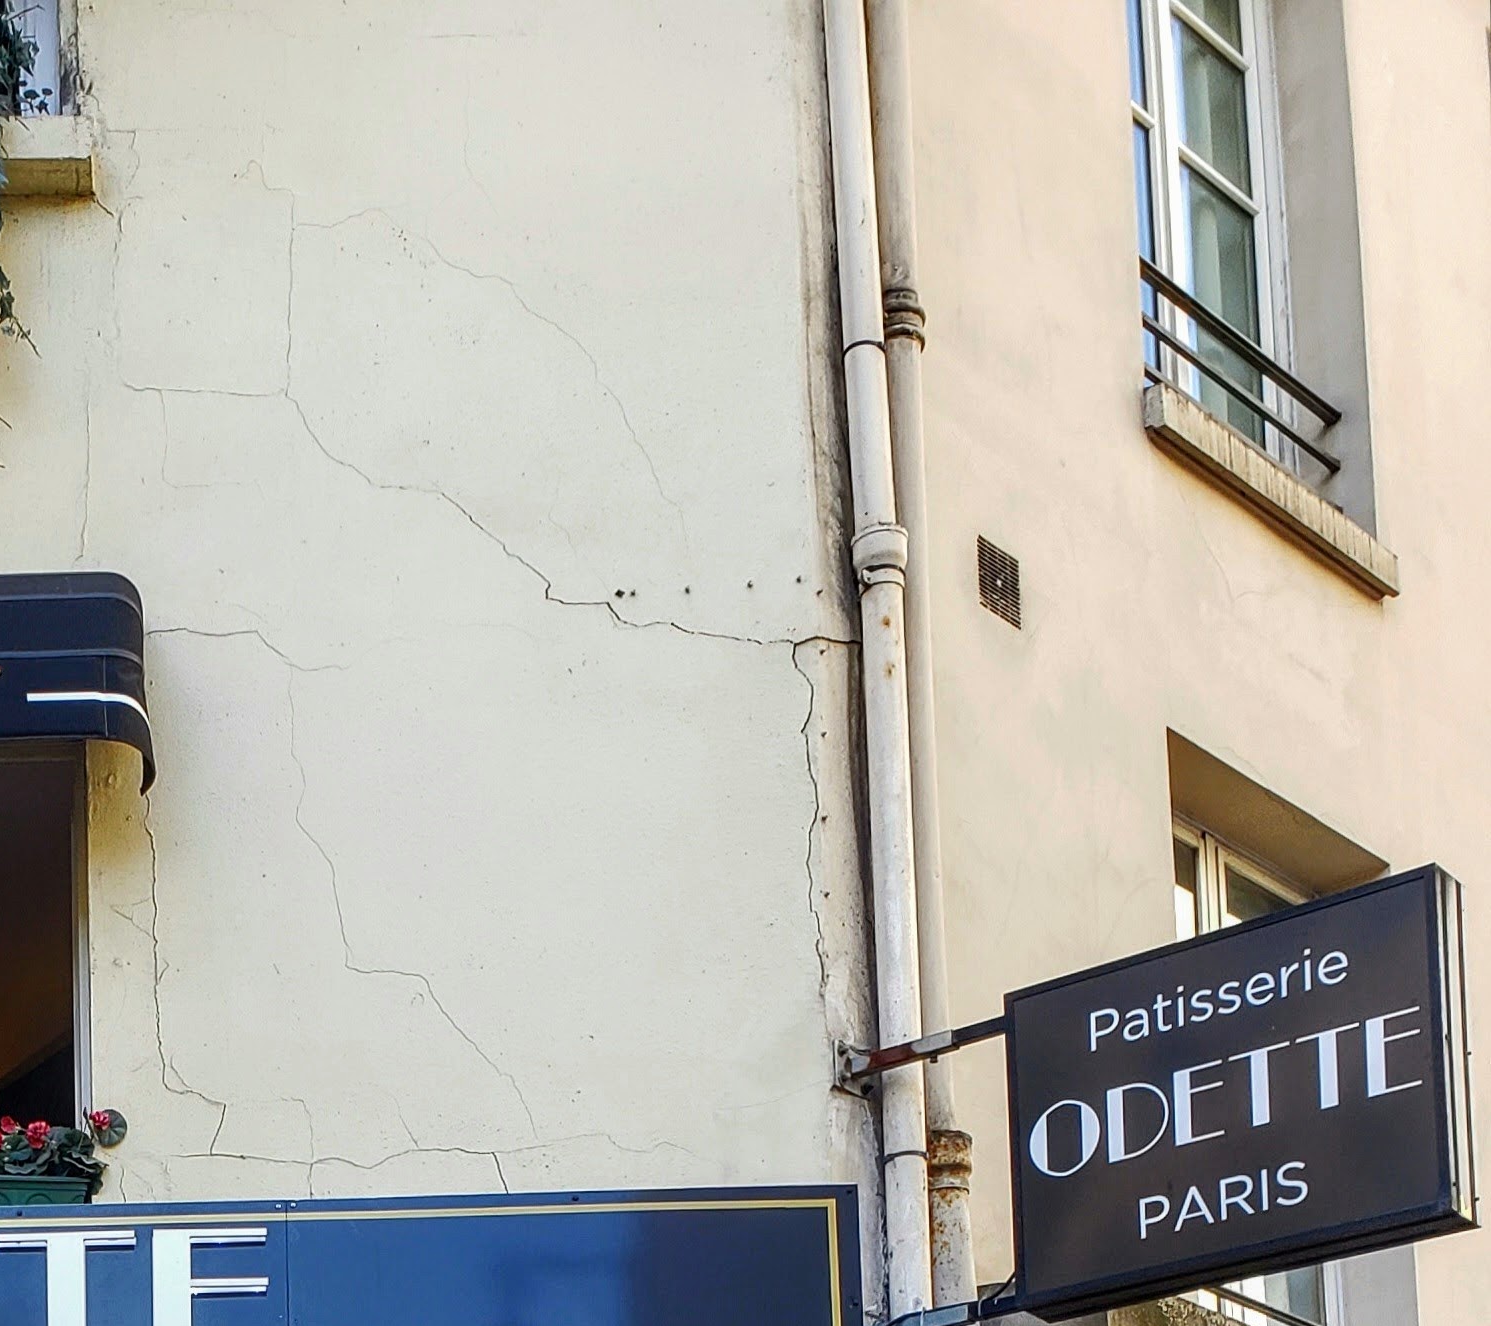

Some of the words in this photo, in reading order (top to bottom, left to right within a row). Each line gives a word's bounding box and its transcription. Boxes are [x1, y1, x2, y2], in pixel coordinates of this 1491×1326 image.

[1089, 948, 1350, 1052] Patisserie
[1028, 1005, 1423, 1178] ODETTE
[1139, 1160, 1309, 1240] PARIS
